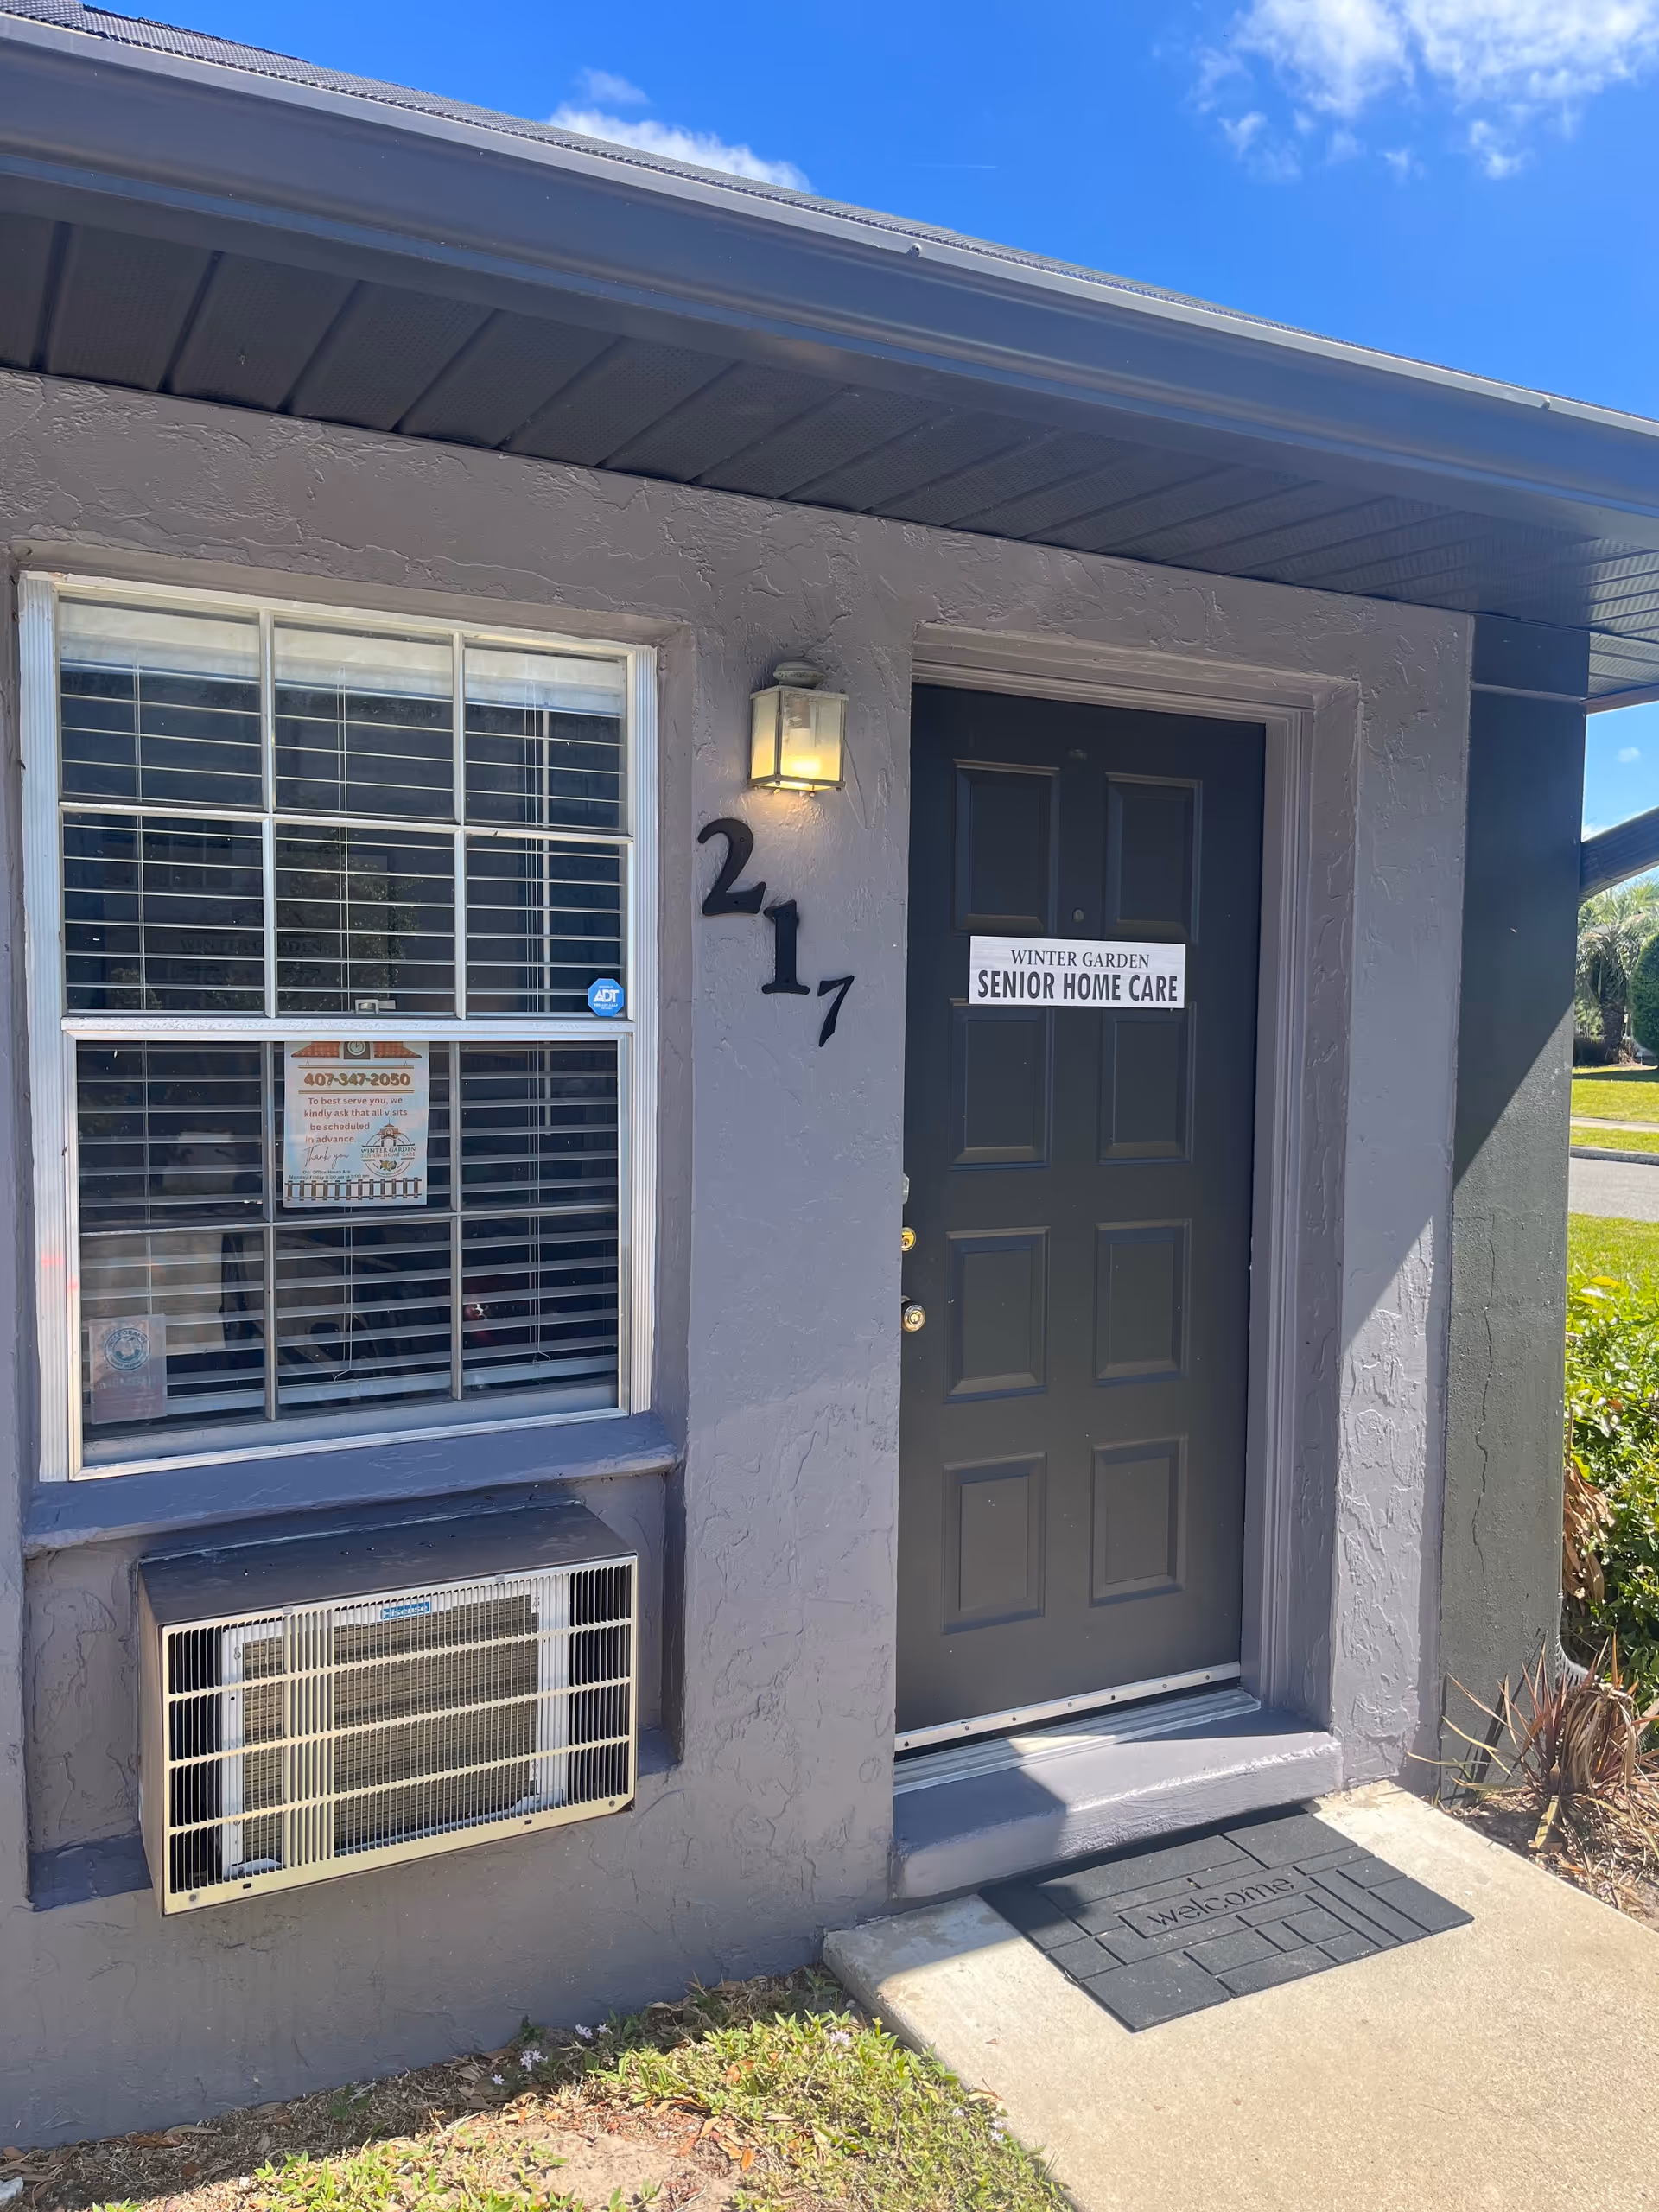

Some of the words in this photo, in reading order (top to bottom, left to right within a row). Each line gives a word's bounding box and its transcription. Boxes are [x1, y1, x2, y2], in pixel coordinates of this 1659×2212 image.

[1010, 950, 1078, 967] WINTER
[1082, 951, 1150, 969] GARDEN
[977, 969, 1055, 1000] SENIOR
[1063, 972, 1121, 1001] HOME
[1128, 974, 1178, 1002] CARE
[593, 988, 620, 1003] ADT
[303, 1072, 411, 1087] 407-347-2050
[321, 1096, 341, 1105] best
[369, 1098, 389, 1107] you,
[303, 1109, 332, 1118] kindly
[334, 1109, 349, 1117] ask
[385, 1108, 408, 1116] visits
[323, 1122, 370, 1131] scheduled
[302, 1144, 331, 1167] Thank
[332, 1154, 349, 1169] you
[1146, 1878, 1294, 1926] welcome
